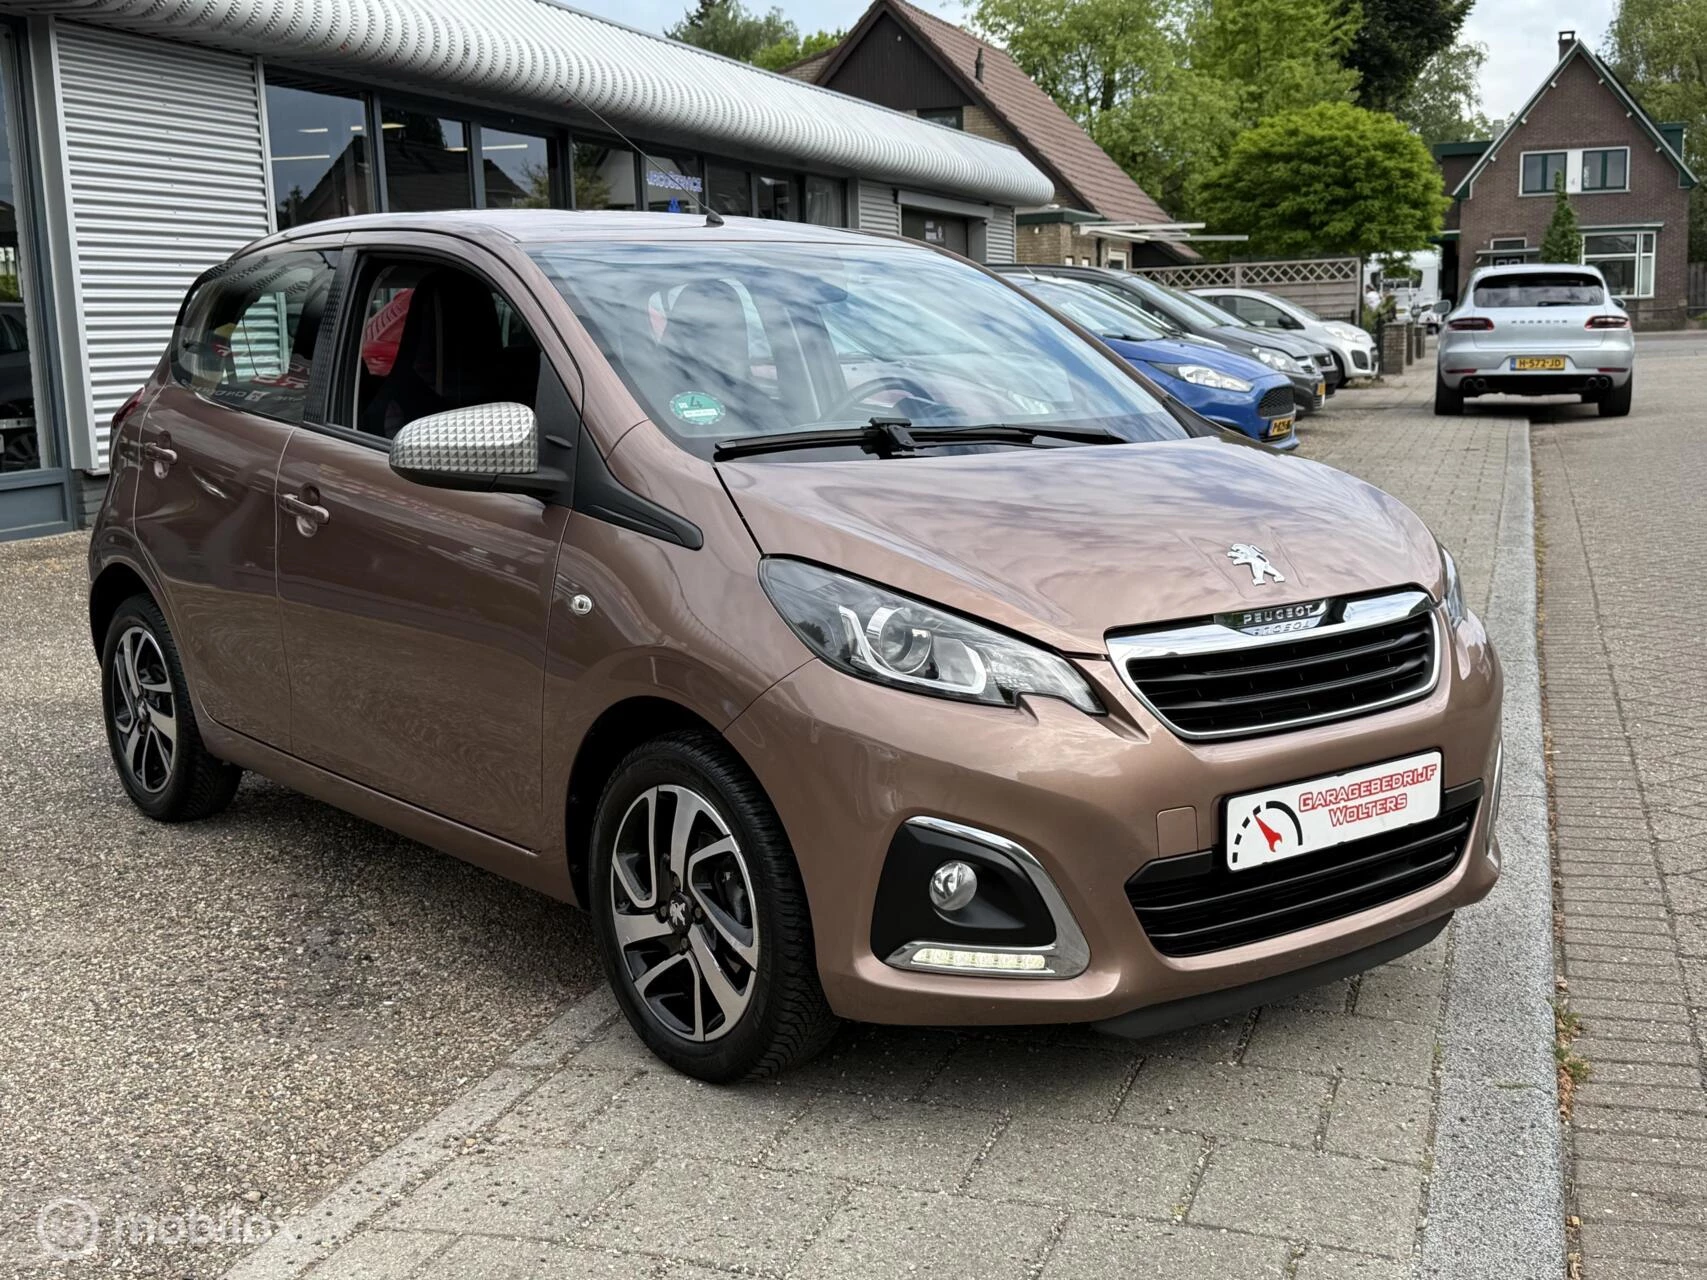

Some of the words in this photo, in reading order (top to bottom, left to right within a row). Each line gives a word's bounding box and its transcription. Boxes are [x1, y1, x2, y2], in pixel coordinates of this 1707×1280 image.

[1243, 604, 1313, 624] PEUGEOT
[1298, 764, 1438, 813] GARAGEBEDRIJF
[1329, 793, 1407, 828] WOLTERS
